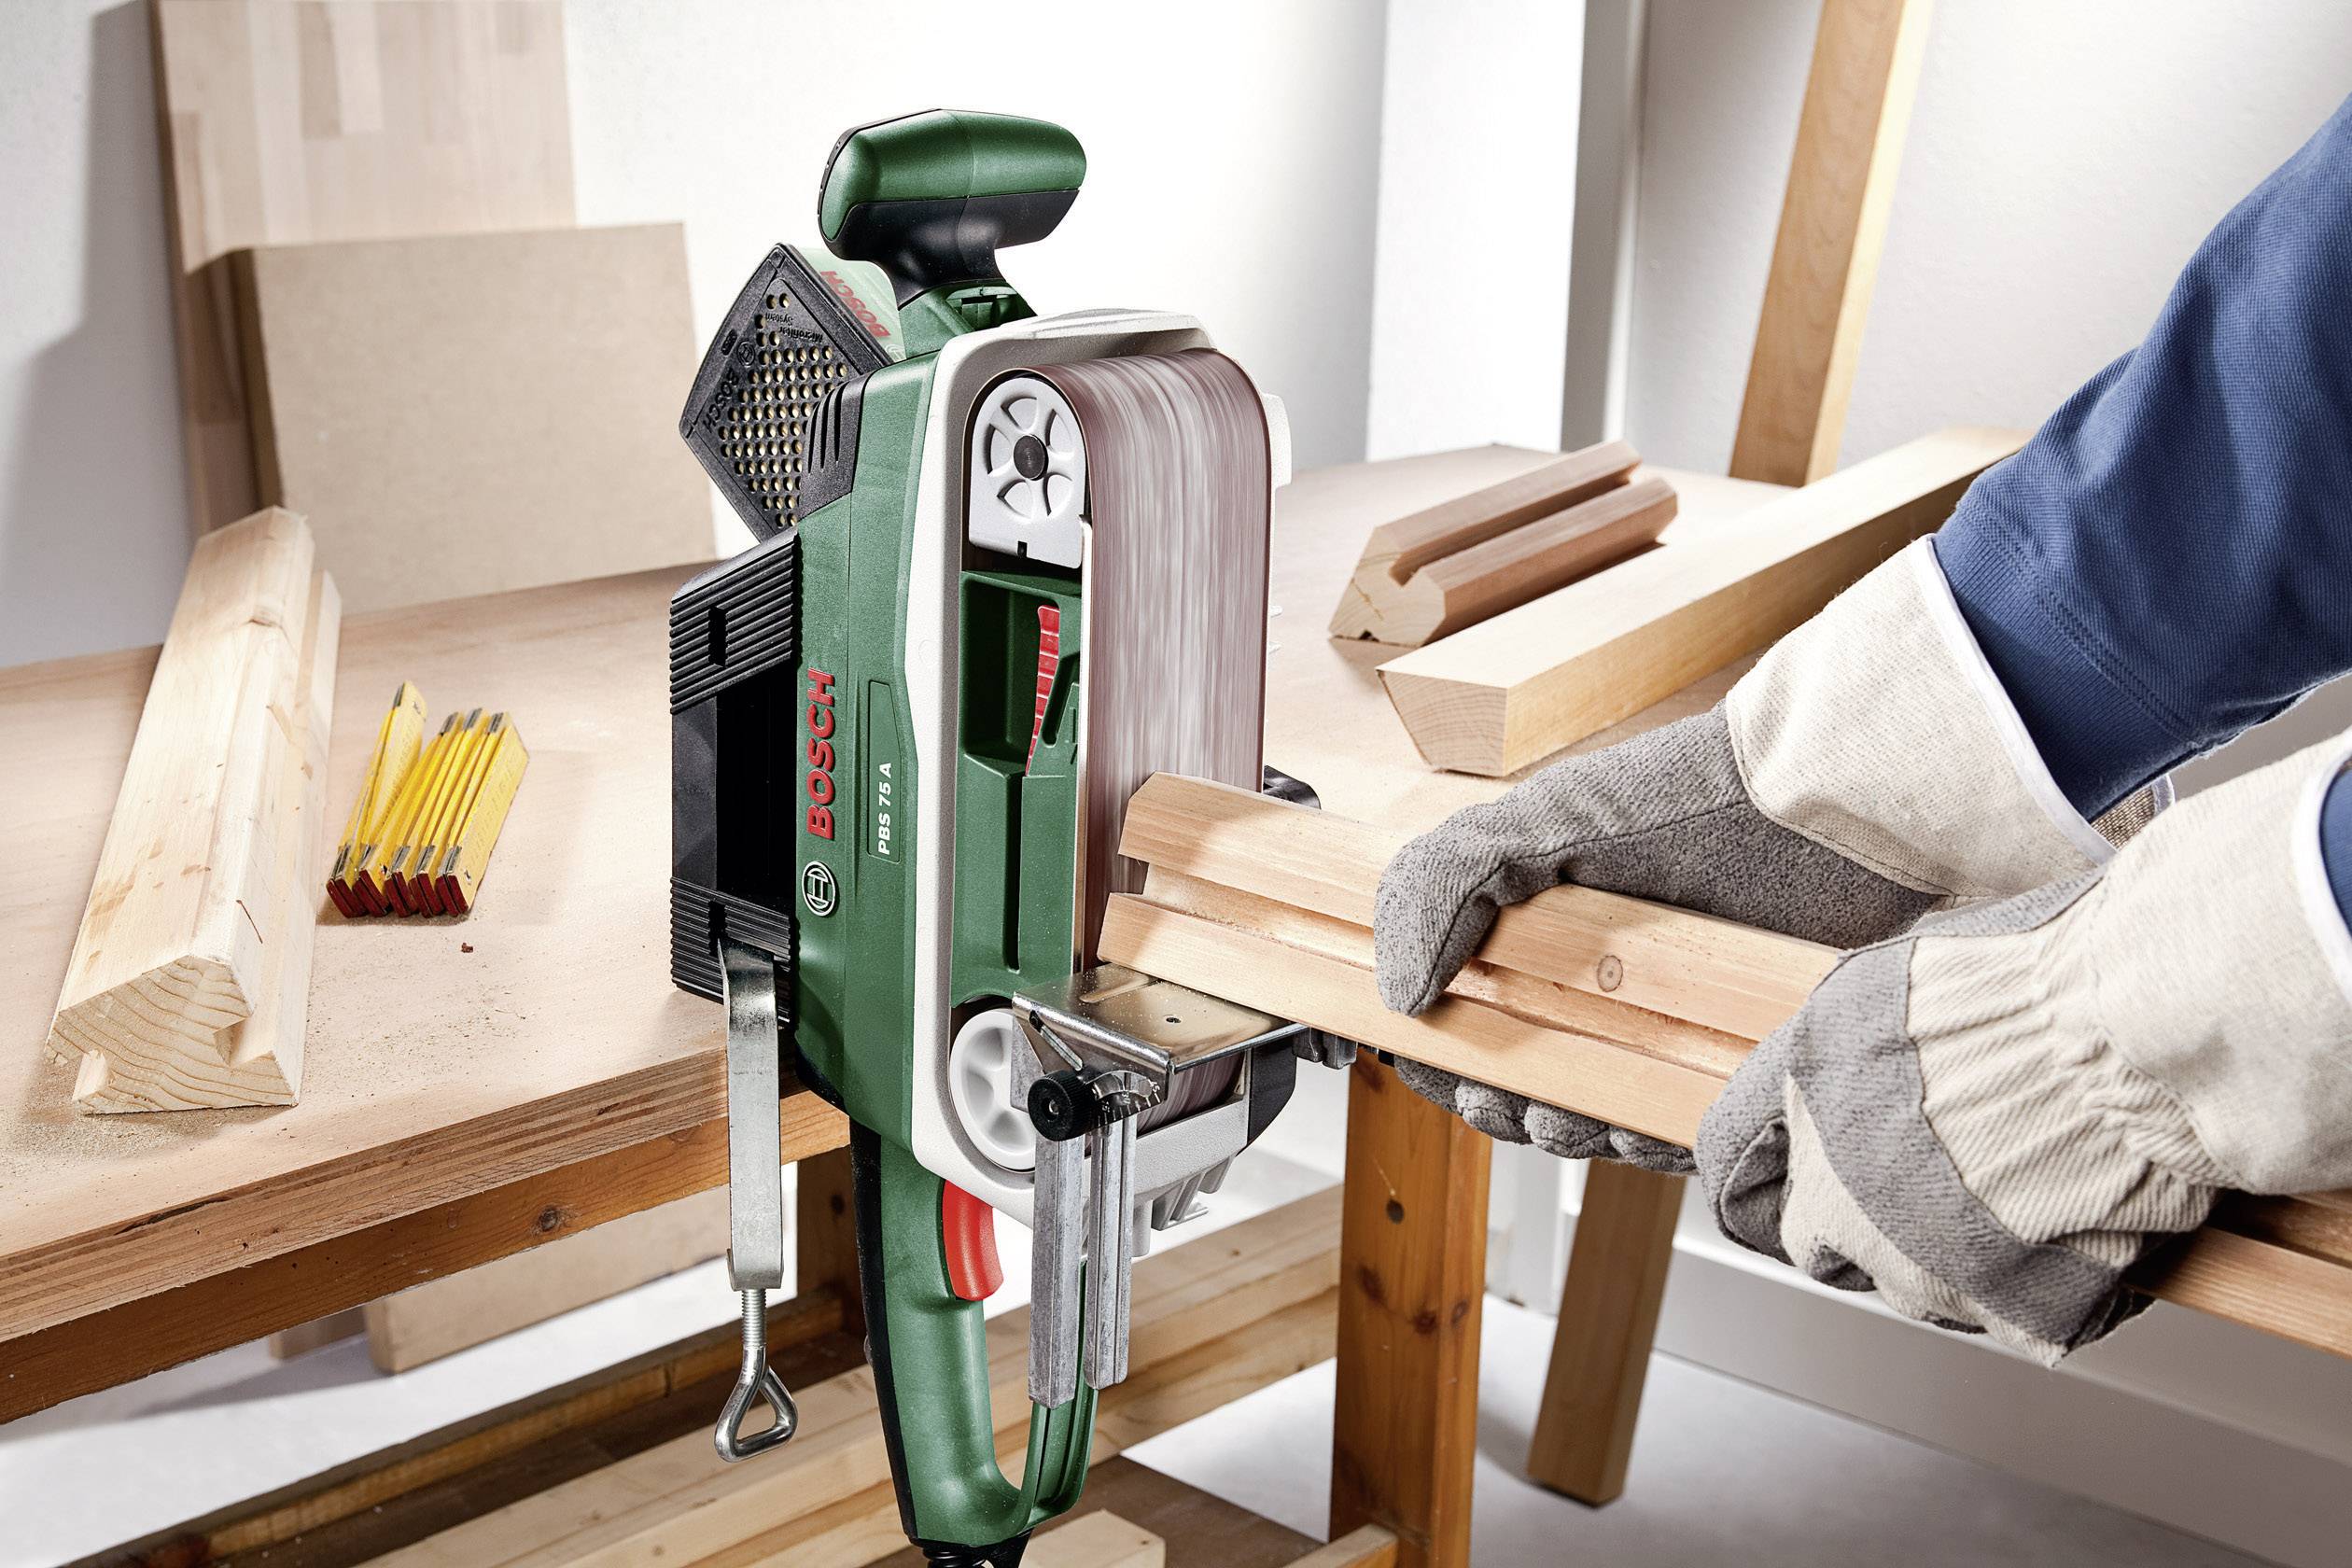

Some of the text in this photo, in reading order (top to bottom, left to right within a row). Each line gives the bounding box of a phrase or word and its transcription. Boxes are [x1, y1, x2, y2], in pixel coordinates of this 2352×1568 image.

[820, 271, 890, 338] BOSCH
[704, 368, 739, 432] BOSCH
[806, 667, 834, 840] BOSCH
[878, 763, 891, 855] PBS 75 A
